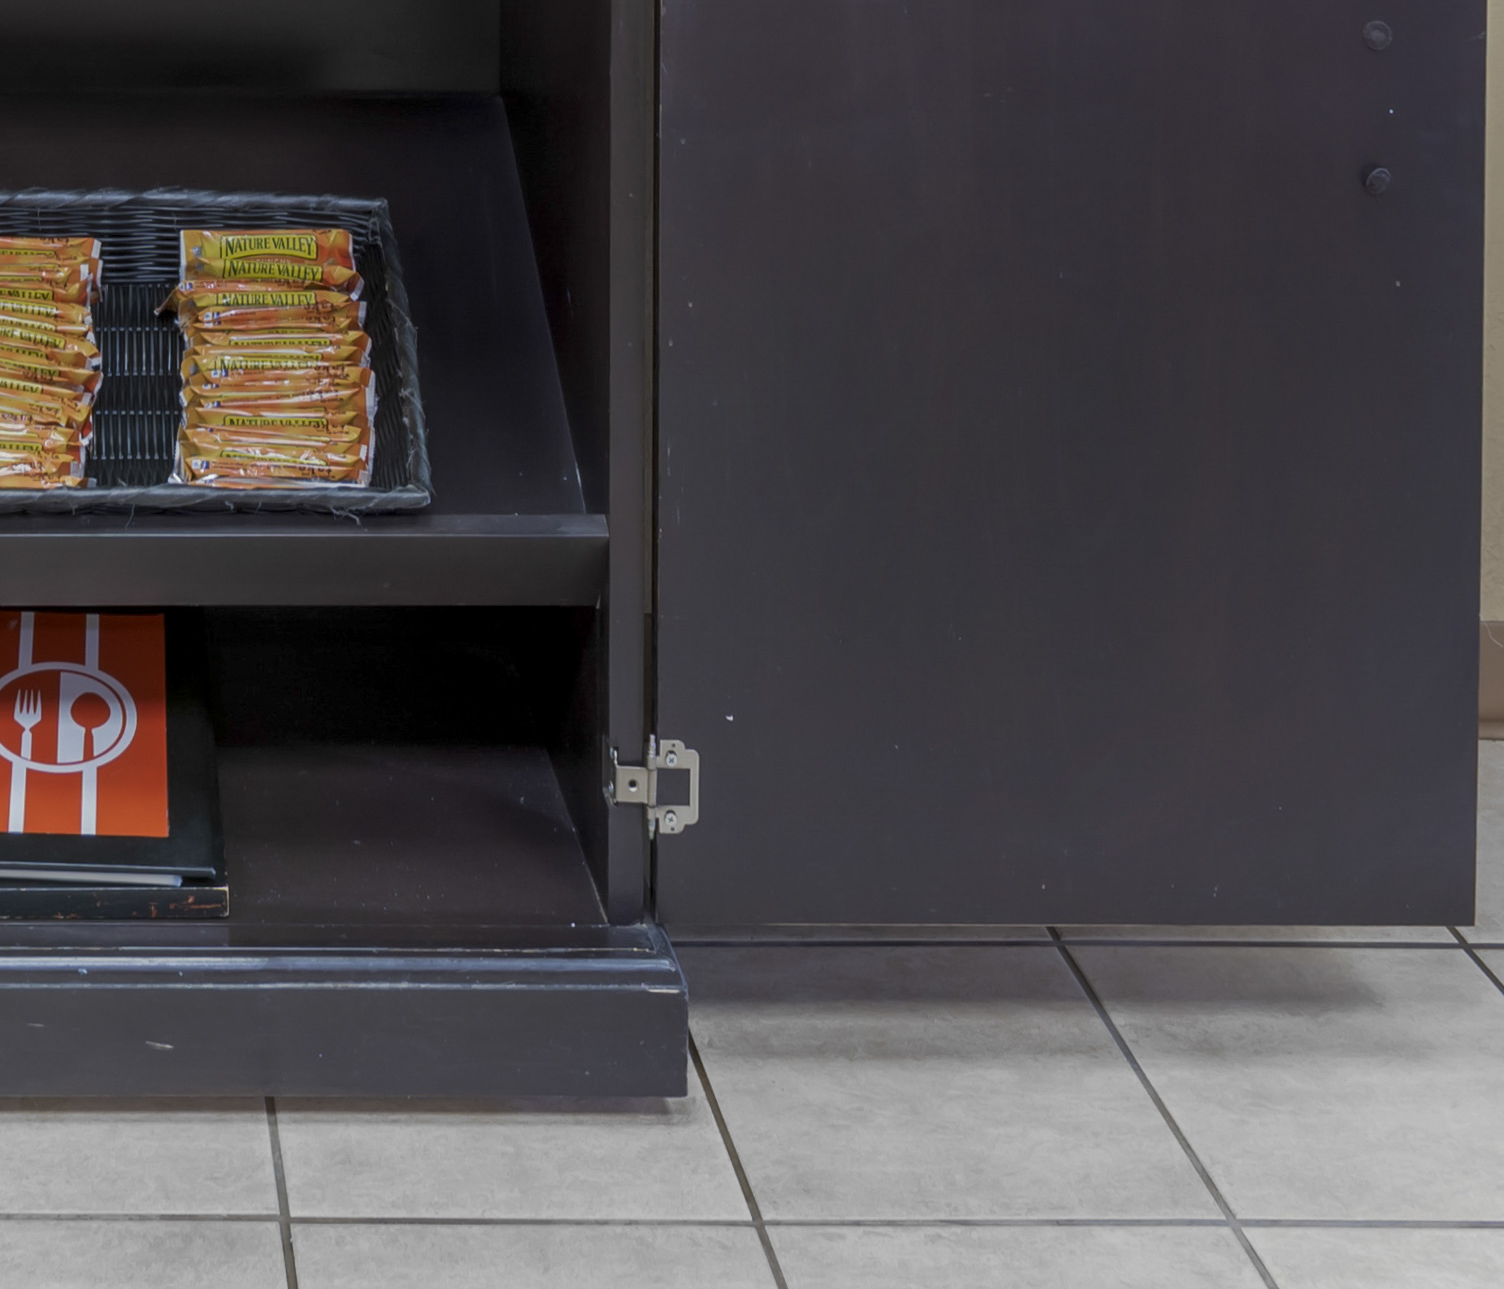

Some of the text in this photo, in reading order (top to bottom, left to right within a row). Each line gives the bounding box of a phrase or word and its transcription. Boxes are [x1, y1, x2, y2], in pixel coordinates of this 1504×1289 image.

[225, 235, 314, 257] NATURE VALLEY
[228, 259, 320, 282] NATURE VALLEY
[221, 292, 313, 306] NATURE VALLEY
